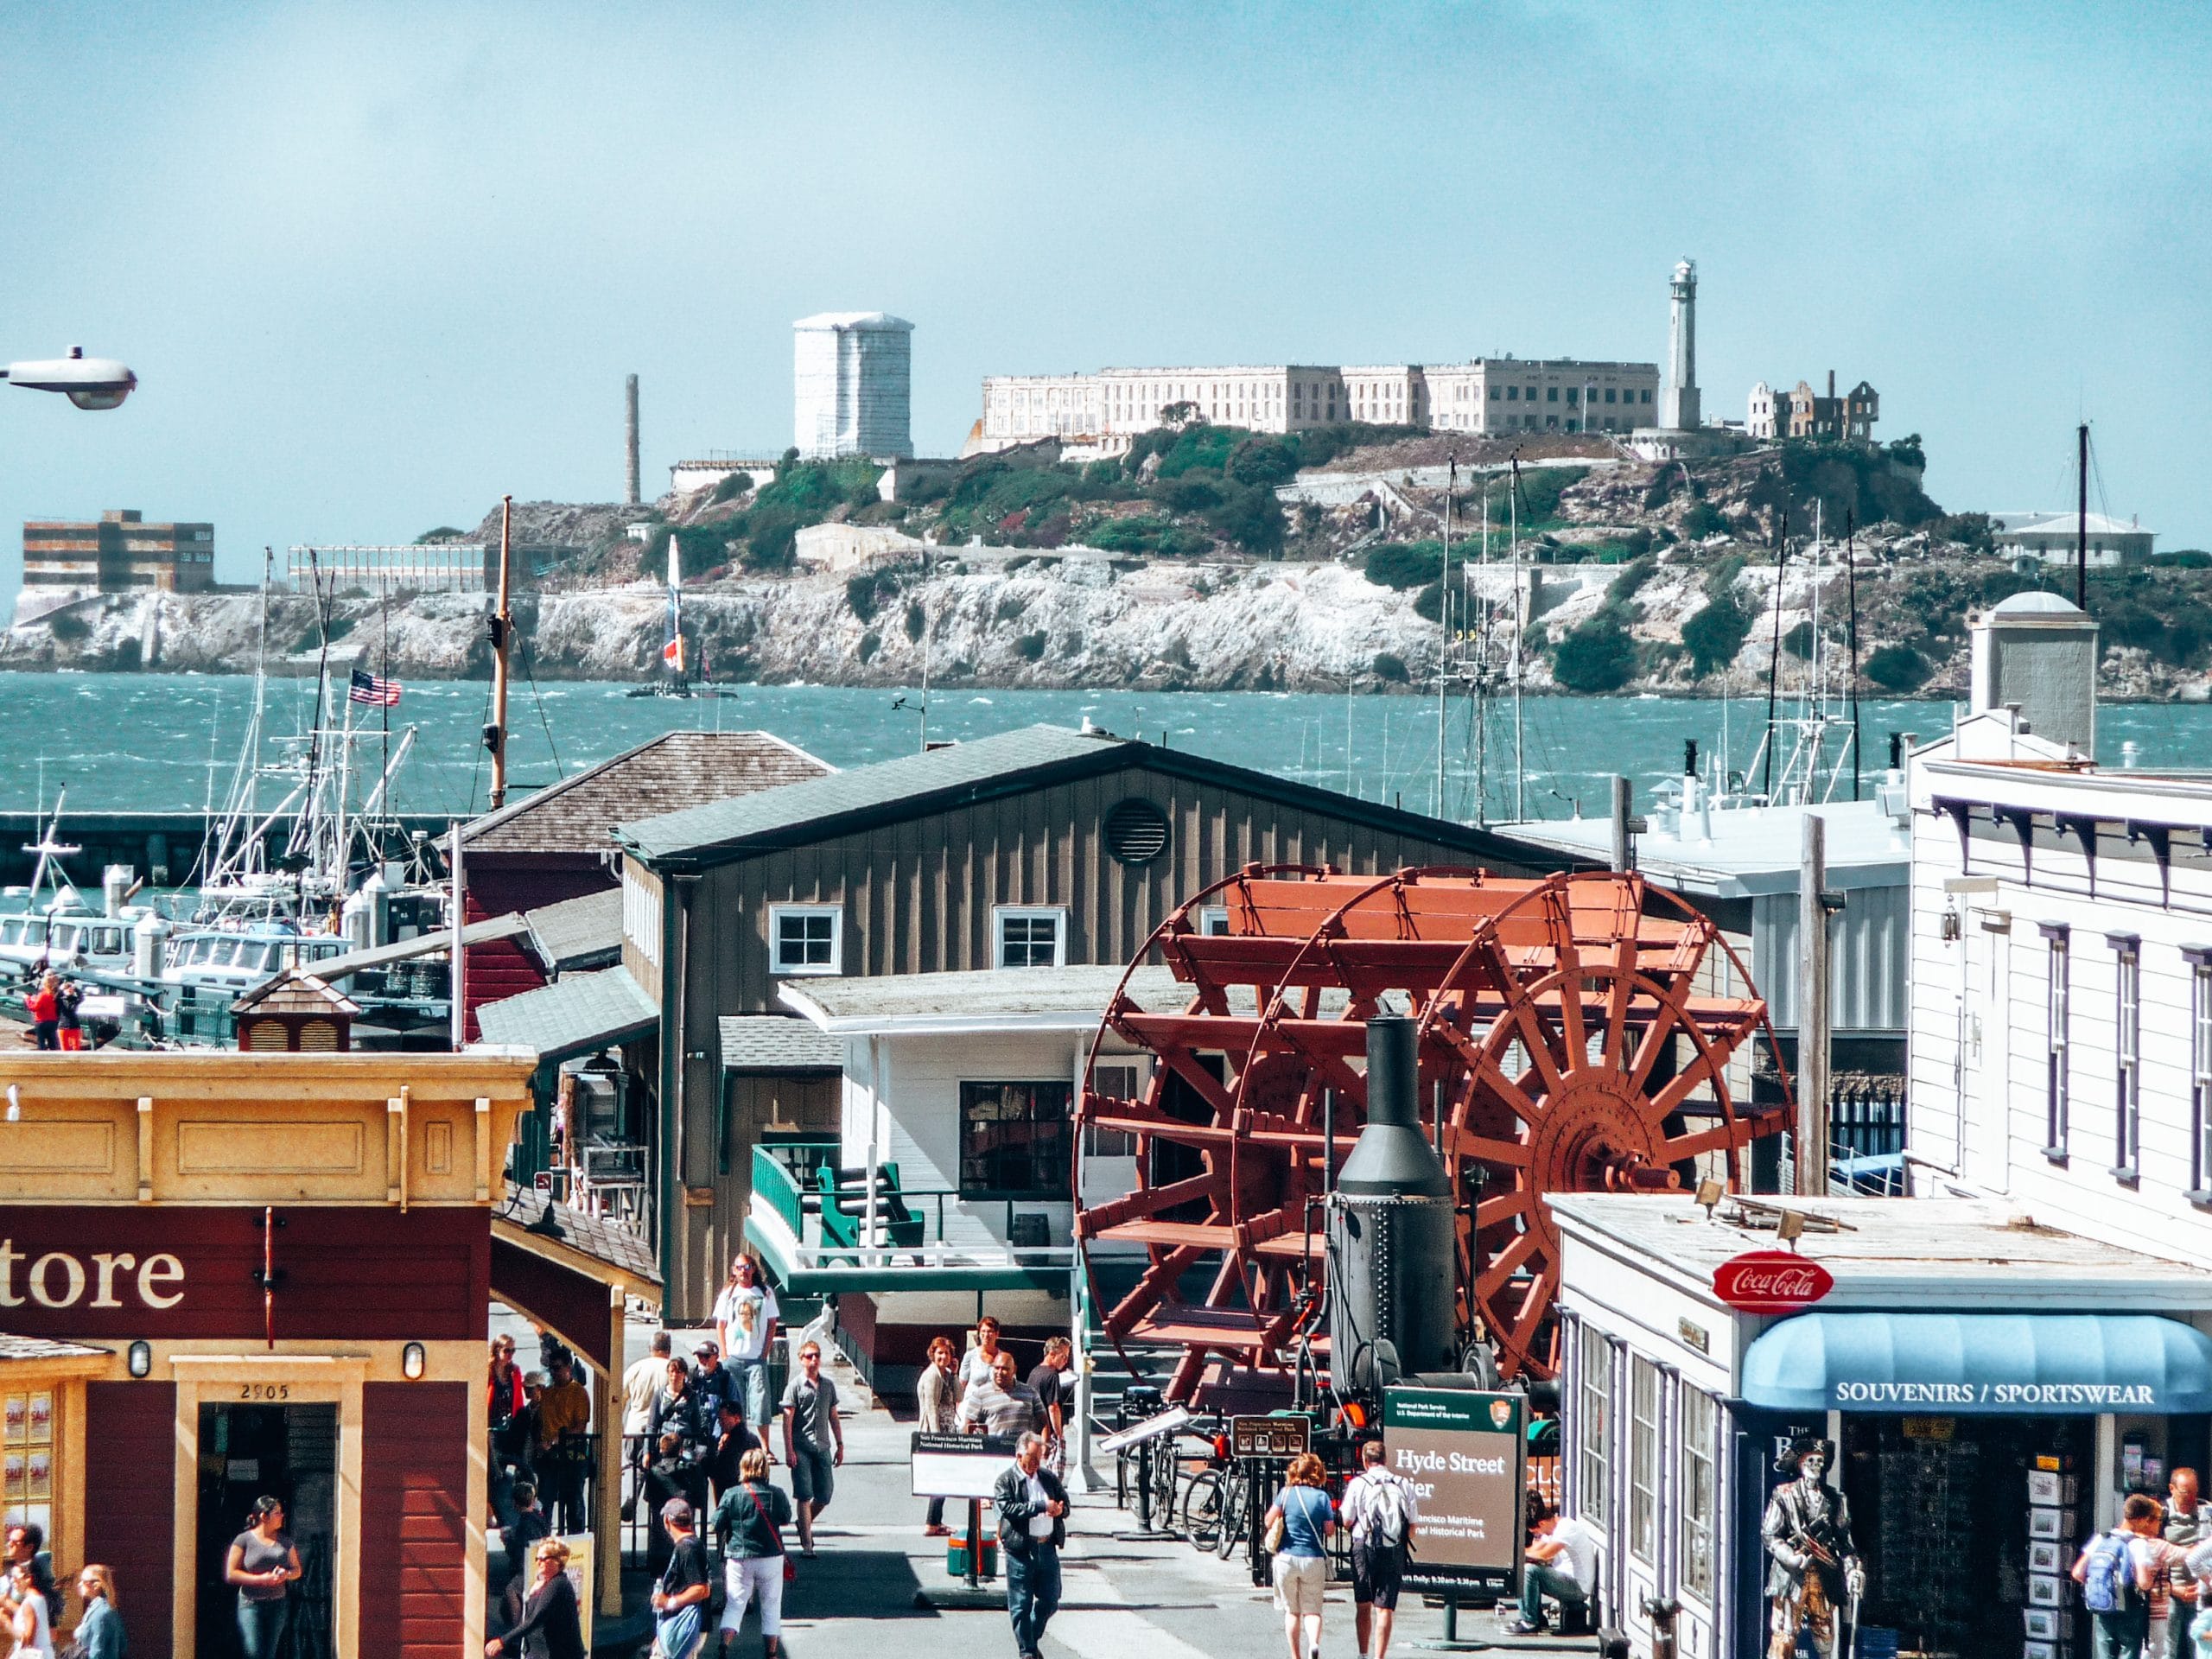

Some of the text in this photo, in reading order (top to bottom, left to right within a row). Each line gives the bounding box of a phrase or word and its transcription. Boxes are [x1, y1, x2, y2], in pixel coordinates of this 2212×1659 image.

[1731, 1267, 1818, 1296] Coca-Cola
[1836, 1382, 1974, 1403] SOUVENIRS
[1994, 1383, 2155, 1404] SPORTSWEAR
[1395, 1448, 1505, 1475] Hyde Street
[1408, 1477, 1435, 1498] ier
[1417, 1514, 1484, 1527] ancisco Maritime
[1429, 1526, 1465, 1537] Historical
[1466, 1528, 1485, 1539] Park
